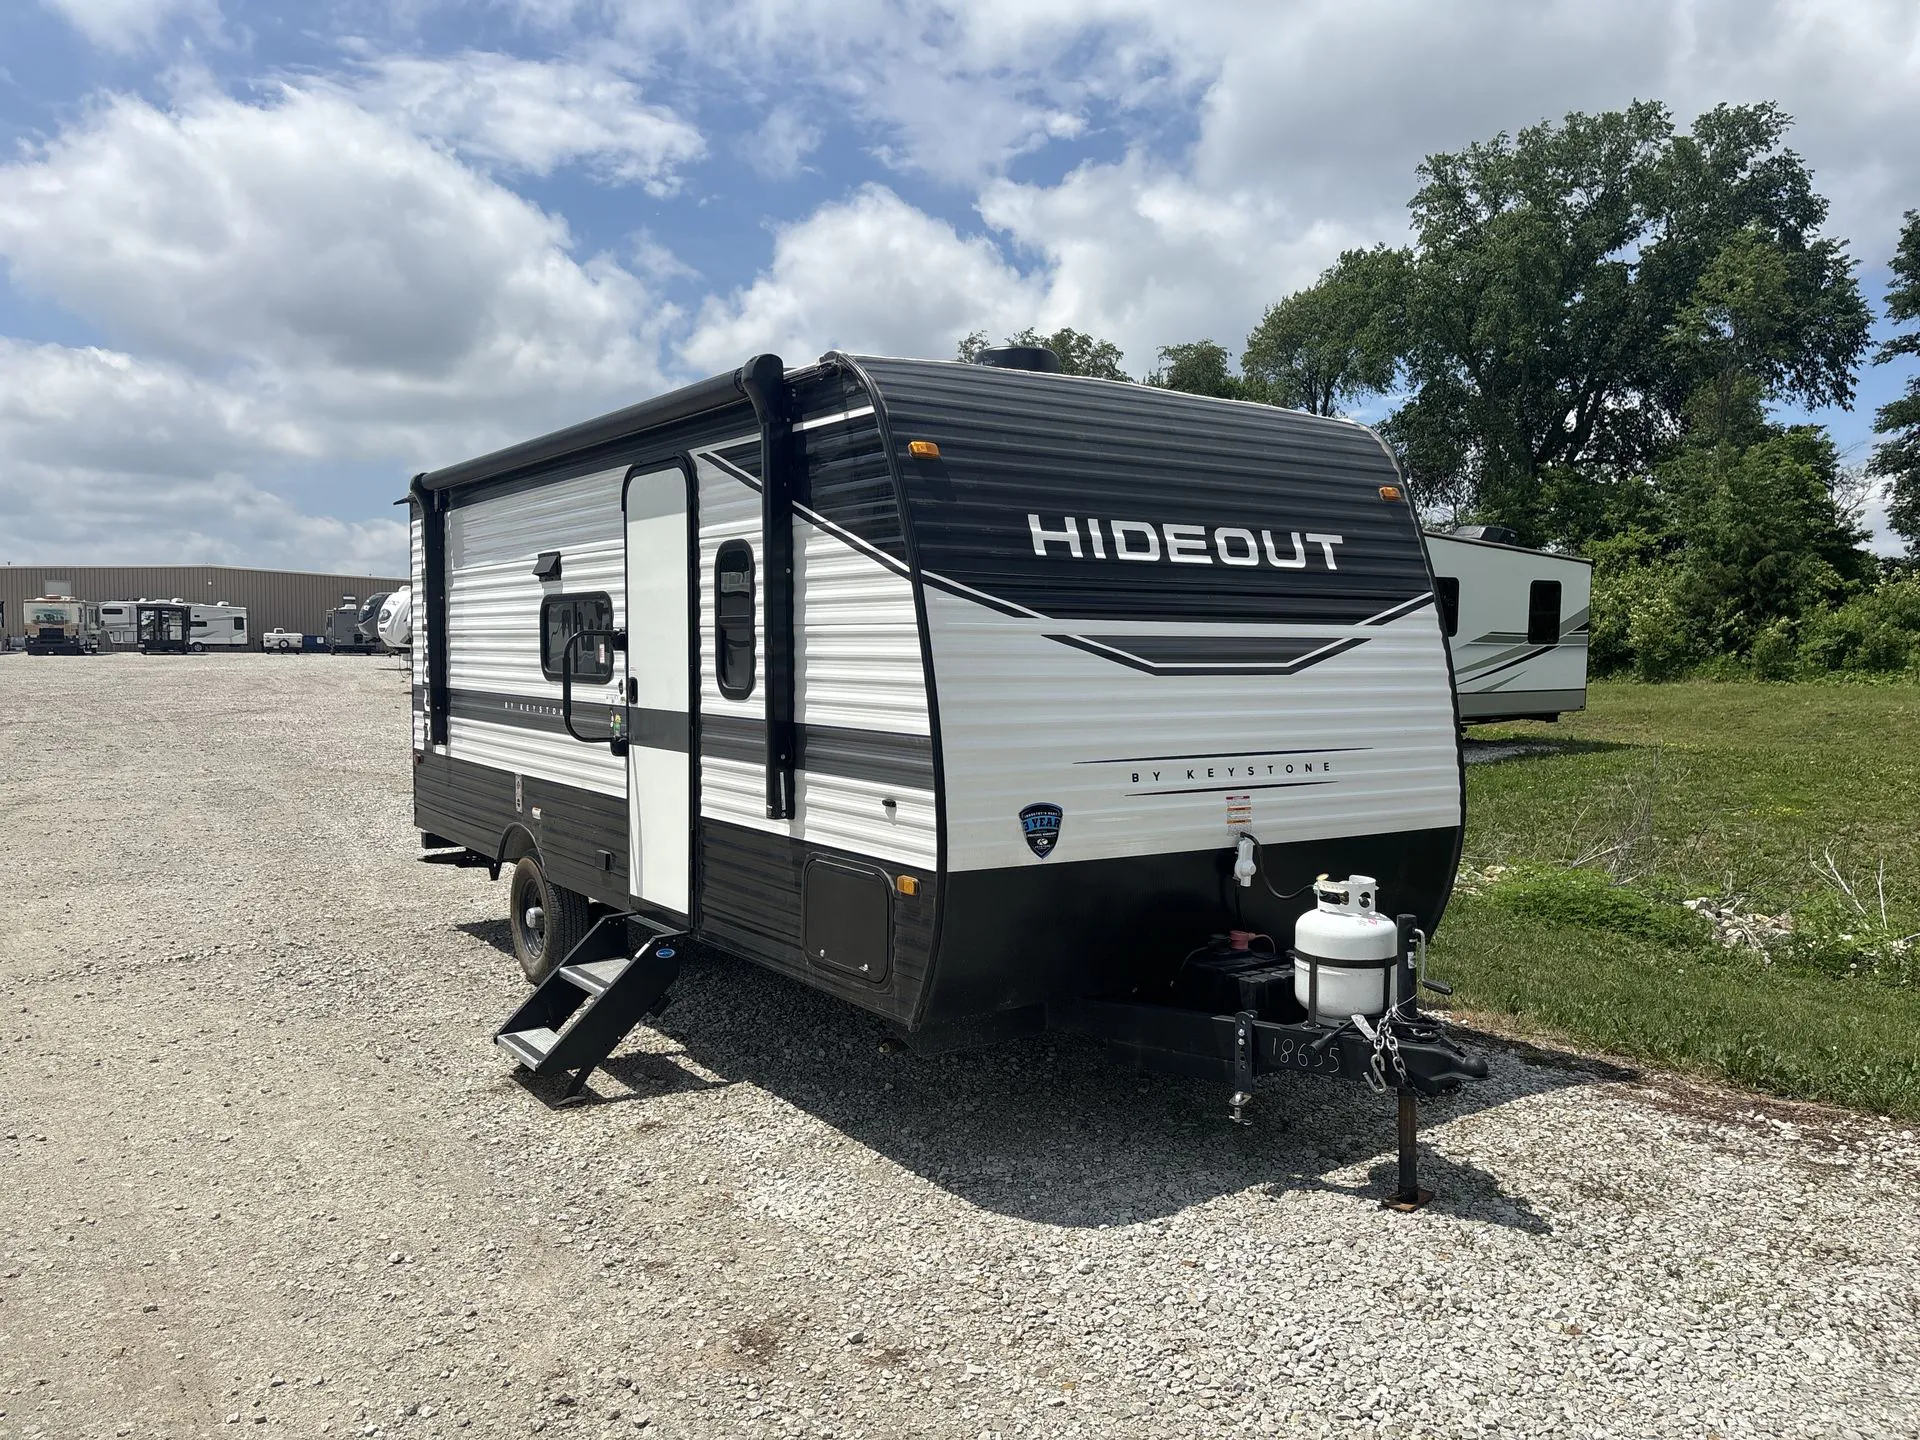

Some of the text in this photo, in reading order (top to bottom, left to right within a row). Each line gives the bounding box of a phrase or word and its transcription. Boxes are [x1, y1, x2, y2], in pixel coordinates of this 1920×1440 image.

[1027, 514, 1344, 570] HIDEOUT
[520, 703, 564, 716] KEYSTON
[1131, 762, 1331, 783] BY KEYSTONE
[1023, 817, 1061, 831] 3 YEAR
